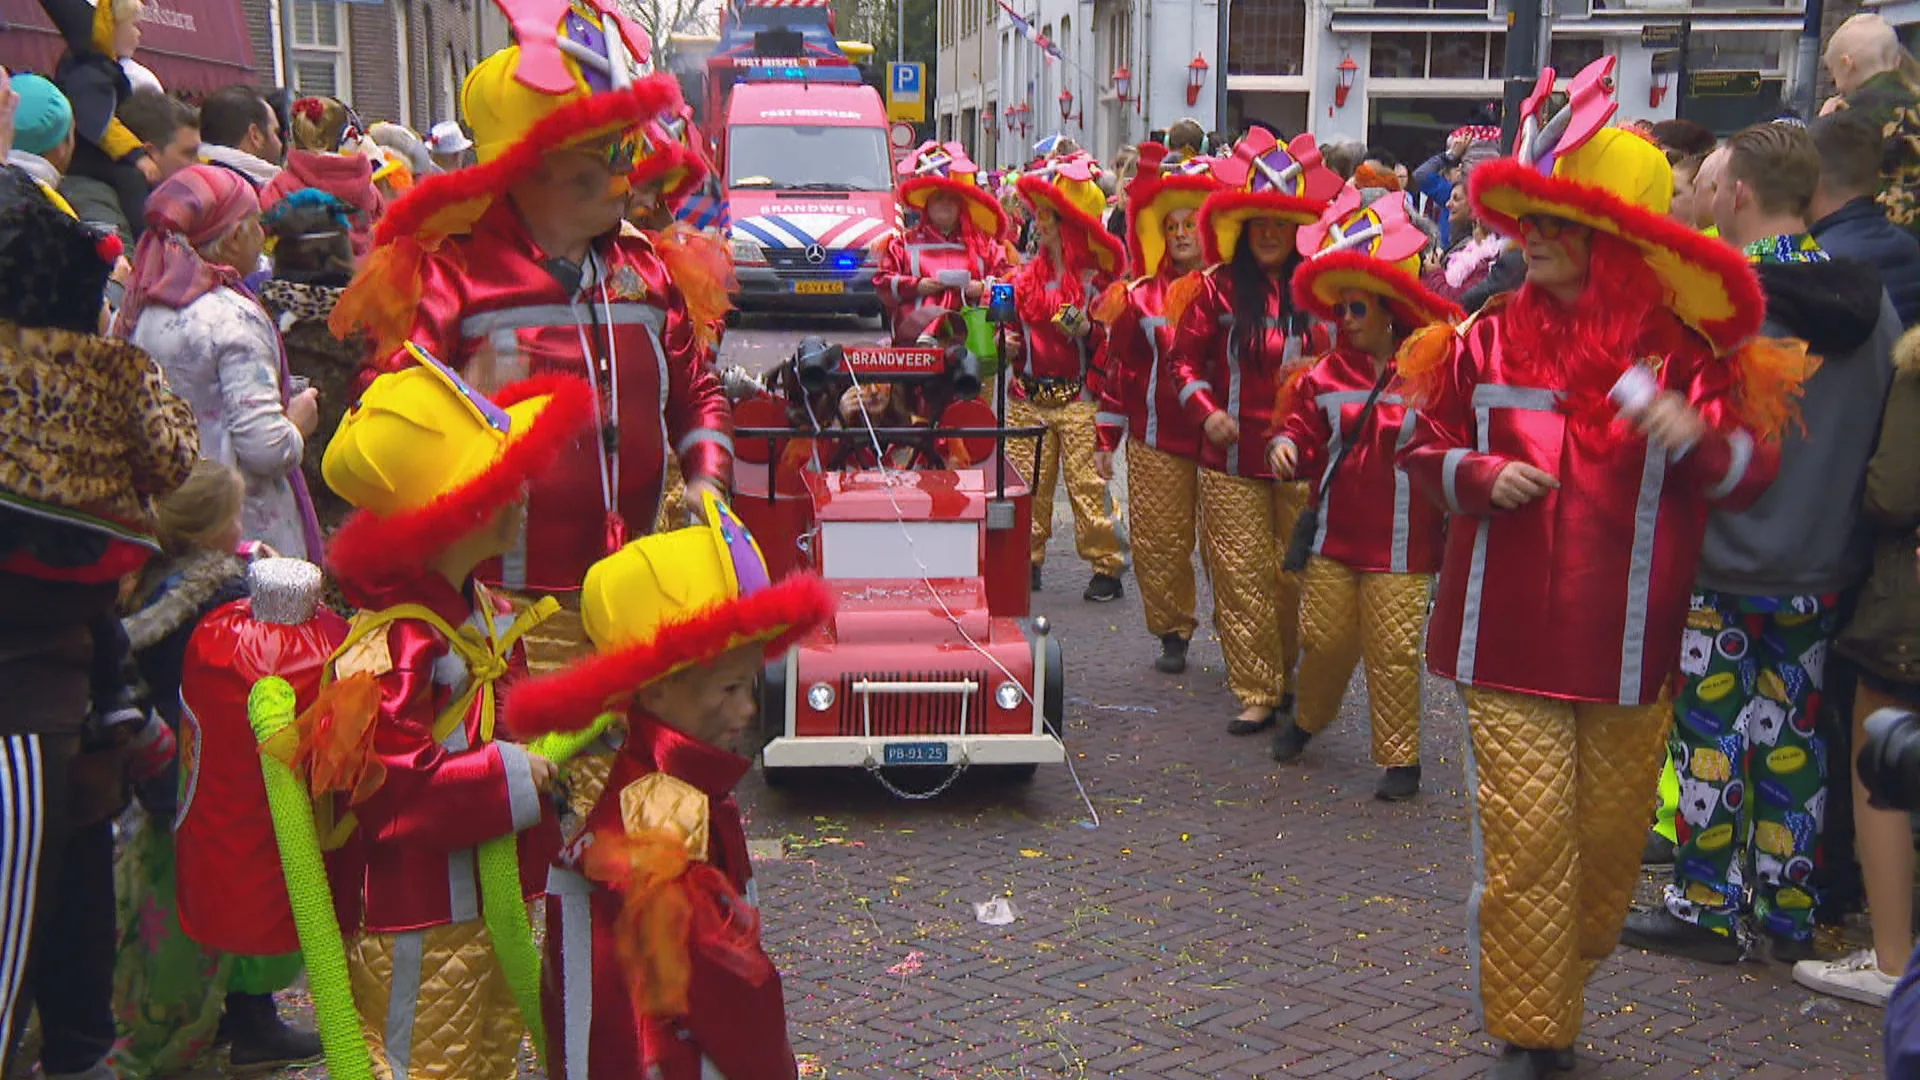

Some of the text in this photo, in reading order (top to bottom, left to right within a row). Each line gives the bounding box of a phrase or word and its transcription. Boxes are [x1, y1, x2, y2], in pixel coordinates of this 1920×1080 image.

[898, 67, 914, 90] P
[760, 204, 867, 216] BRANDWEER
[852, 351, 931, 367] BRANDWEER
